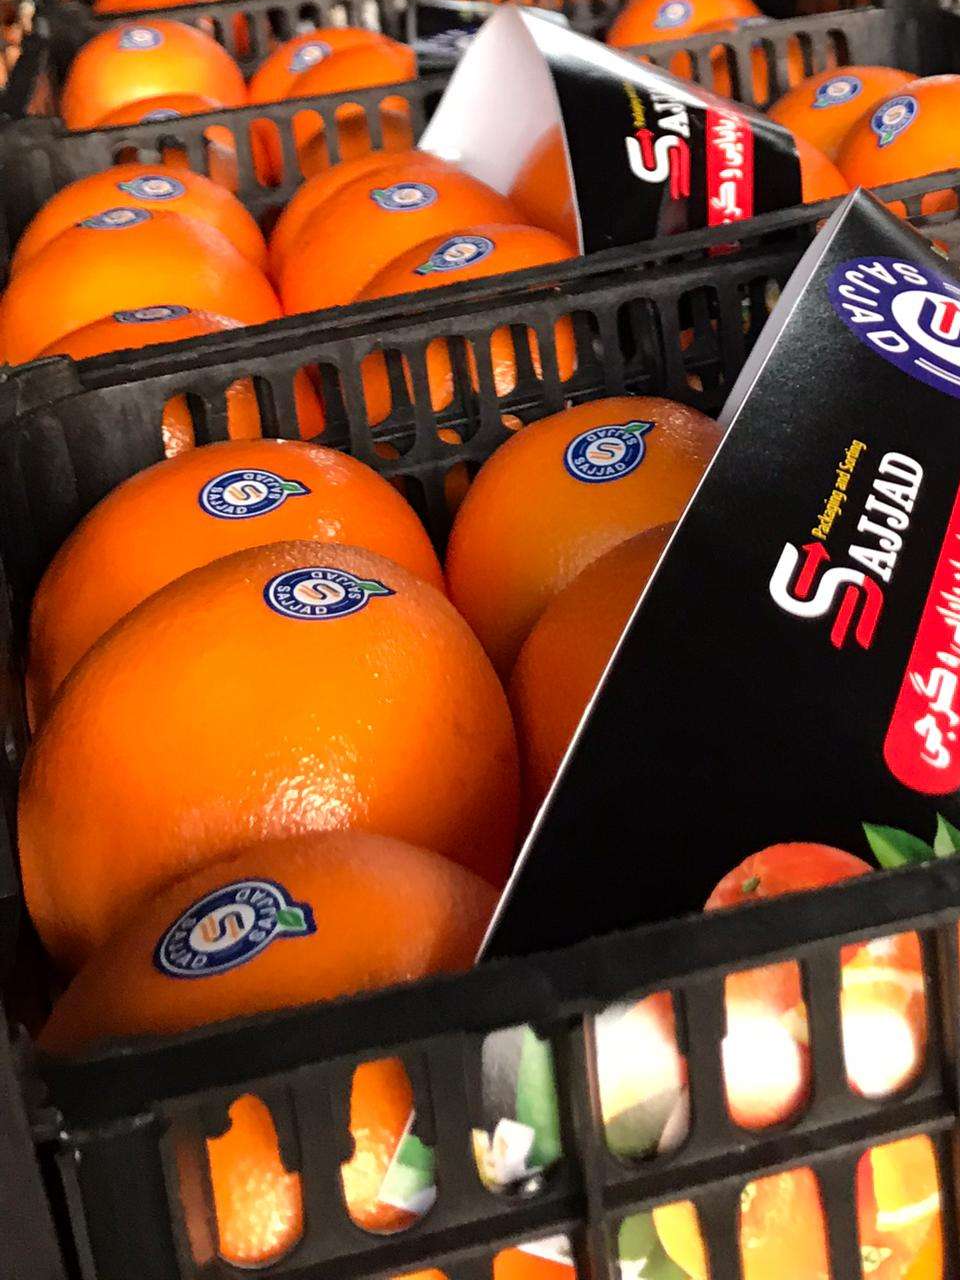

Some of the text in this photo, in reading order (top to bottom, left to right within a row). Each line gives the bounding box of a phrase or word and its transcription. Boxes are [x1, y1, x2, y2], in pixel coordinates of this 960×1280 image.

[838, 261, 929, 353] SAJJAD
[574, 456, 626, 476] SAJJAD
[811, 439, 867, 540] Packaging and Sorting
[208, 486, 248, 514] SAJJAD
[277, 585, 328, 615] SAJJAD
[908, 667, 960, 769] گرجی
[235, 887, 277, 944] SAJJAD
